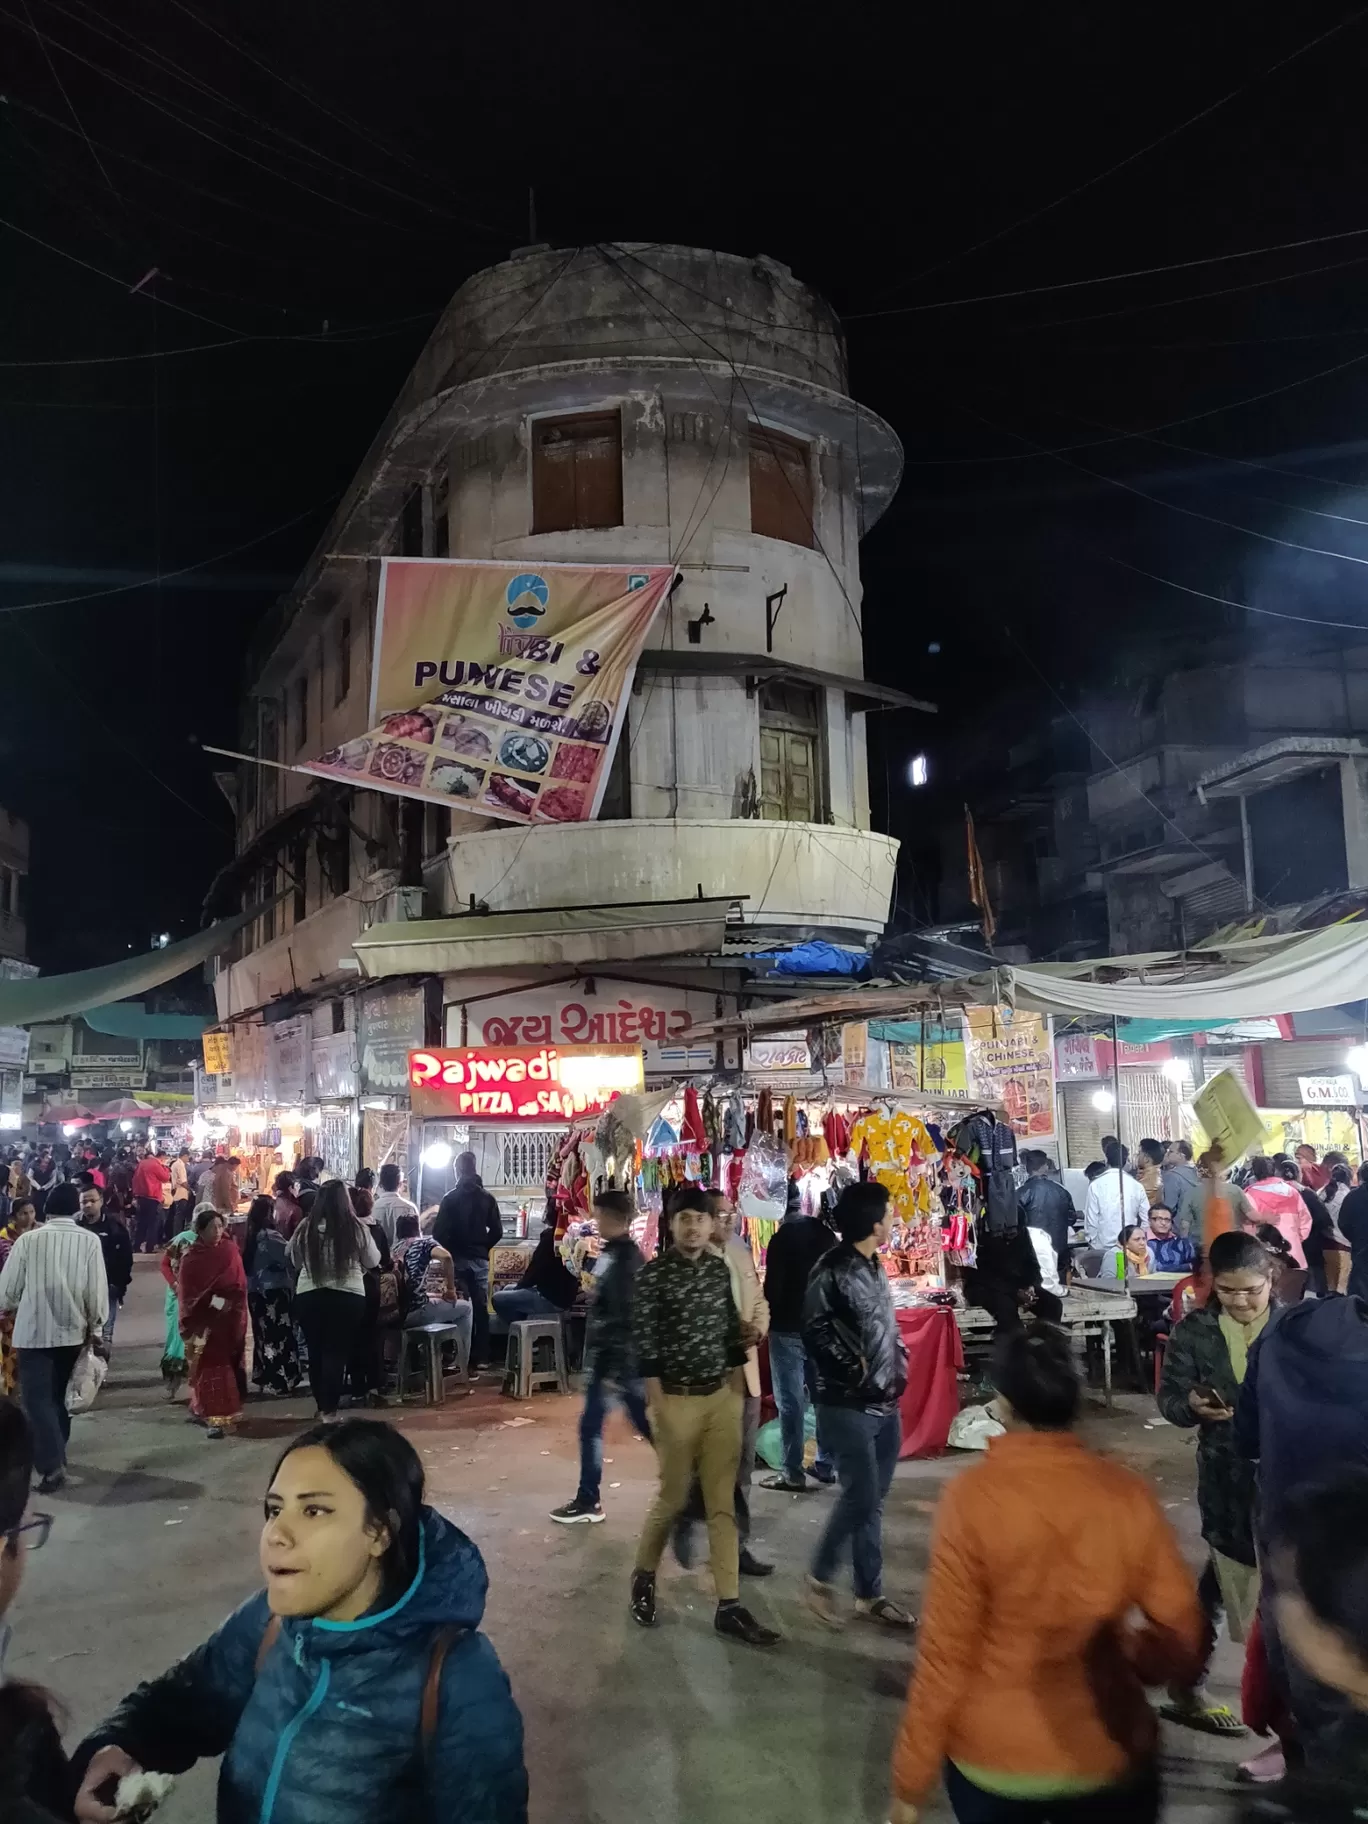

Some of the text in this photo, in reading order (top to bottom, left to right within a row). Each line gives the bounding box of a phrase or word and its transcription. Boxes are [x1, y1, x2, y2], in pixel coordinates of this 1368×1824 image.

[576, 649, 601, 675] &
[484, 700, 526, 723] ખીચડી
[482, 1015, 555, 1046] જય
[980, 1036, 1039, 1051] PUNJABI &
[986, 1049, 1035, 1062] CHINESE
[411, 1049, 558, 1090] Rajwadi
[459, 1091, 514, 1114] PIZZA
